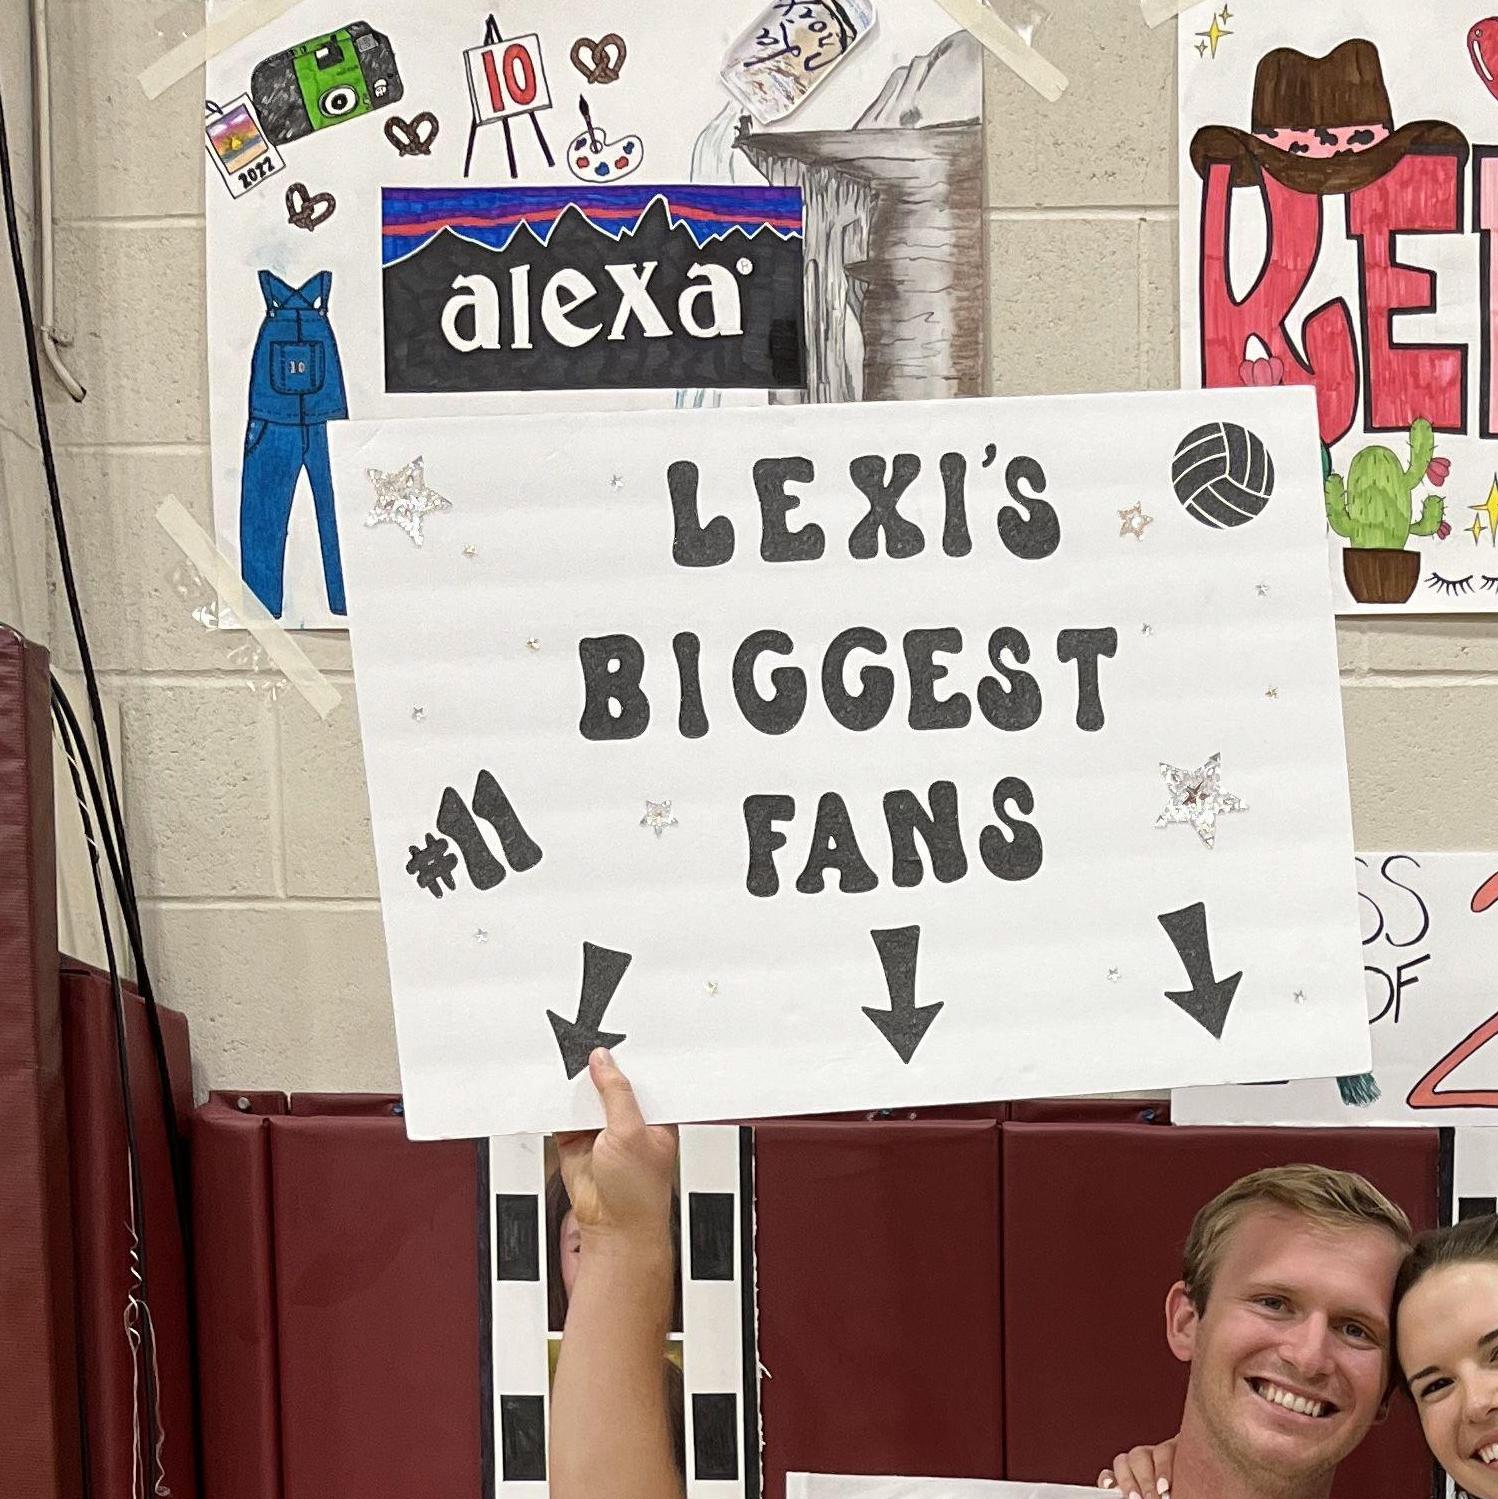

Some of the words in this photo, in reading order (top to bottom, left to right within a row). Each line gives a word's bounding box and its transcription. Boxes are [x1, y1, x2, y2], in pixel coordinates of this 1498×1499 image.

[481, 43, 537, 113] 10
[289, 360, 305, 374] 10
[667, 444, 1060, 567] LEXI'S
[579, 627, 1117, 740] BIGGEST
[406, 770, 542, 898] #11
[743, 777, 1042, 897] FANS
